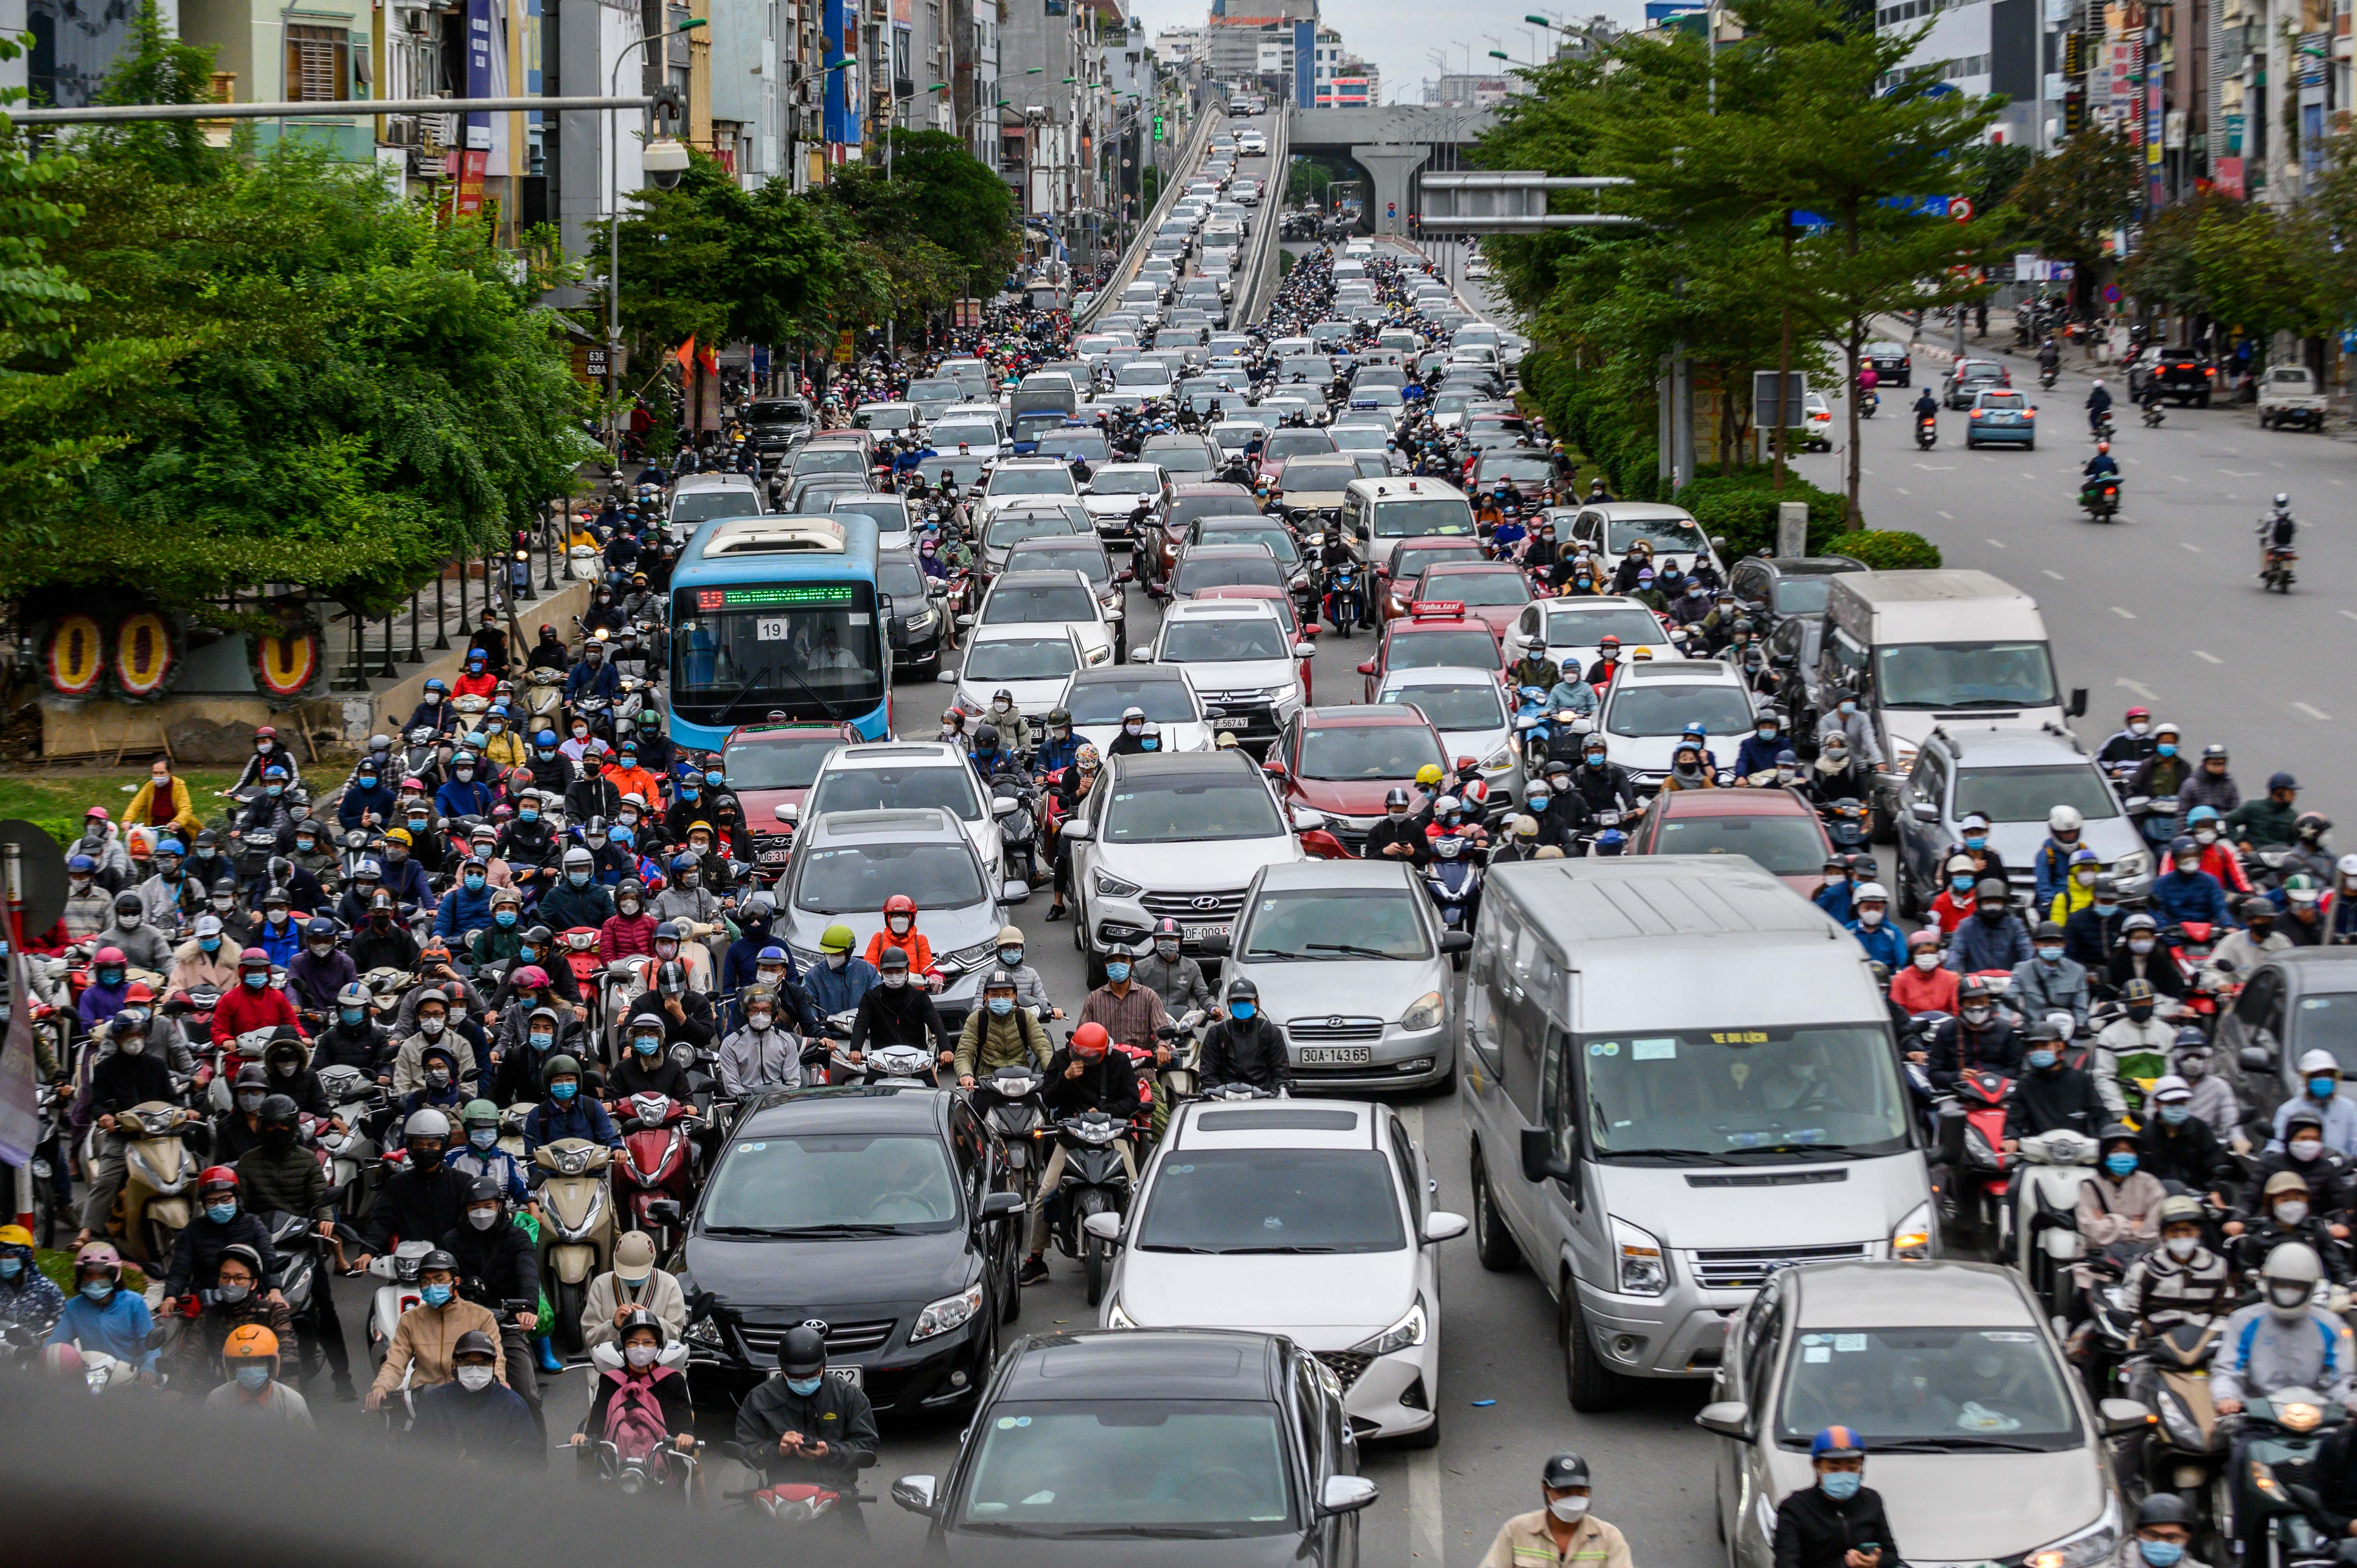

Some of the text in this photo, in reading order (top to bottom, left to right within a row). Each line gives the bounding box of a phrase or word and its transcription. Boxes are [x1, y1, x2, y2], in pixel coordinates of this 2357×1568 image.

[589, 352, 604, 361] 636
[587, 365, 607, 374] 630A
[700, 591, 722, 608] 19
[763, 624, 780, 637] 19
[1304, 1049, 1367, 1062] 30A-143.65
